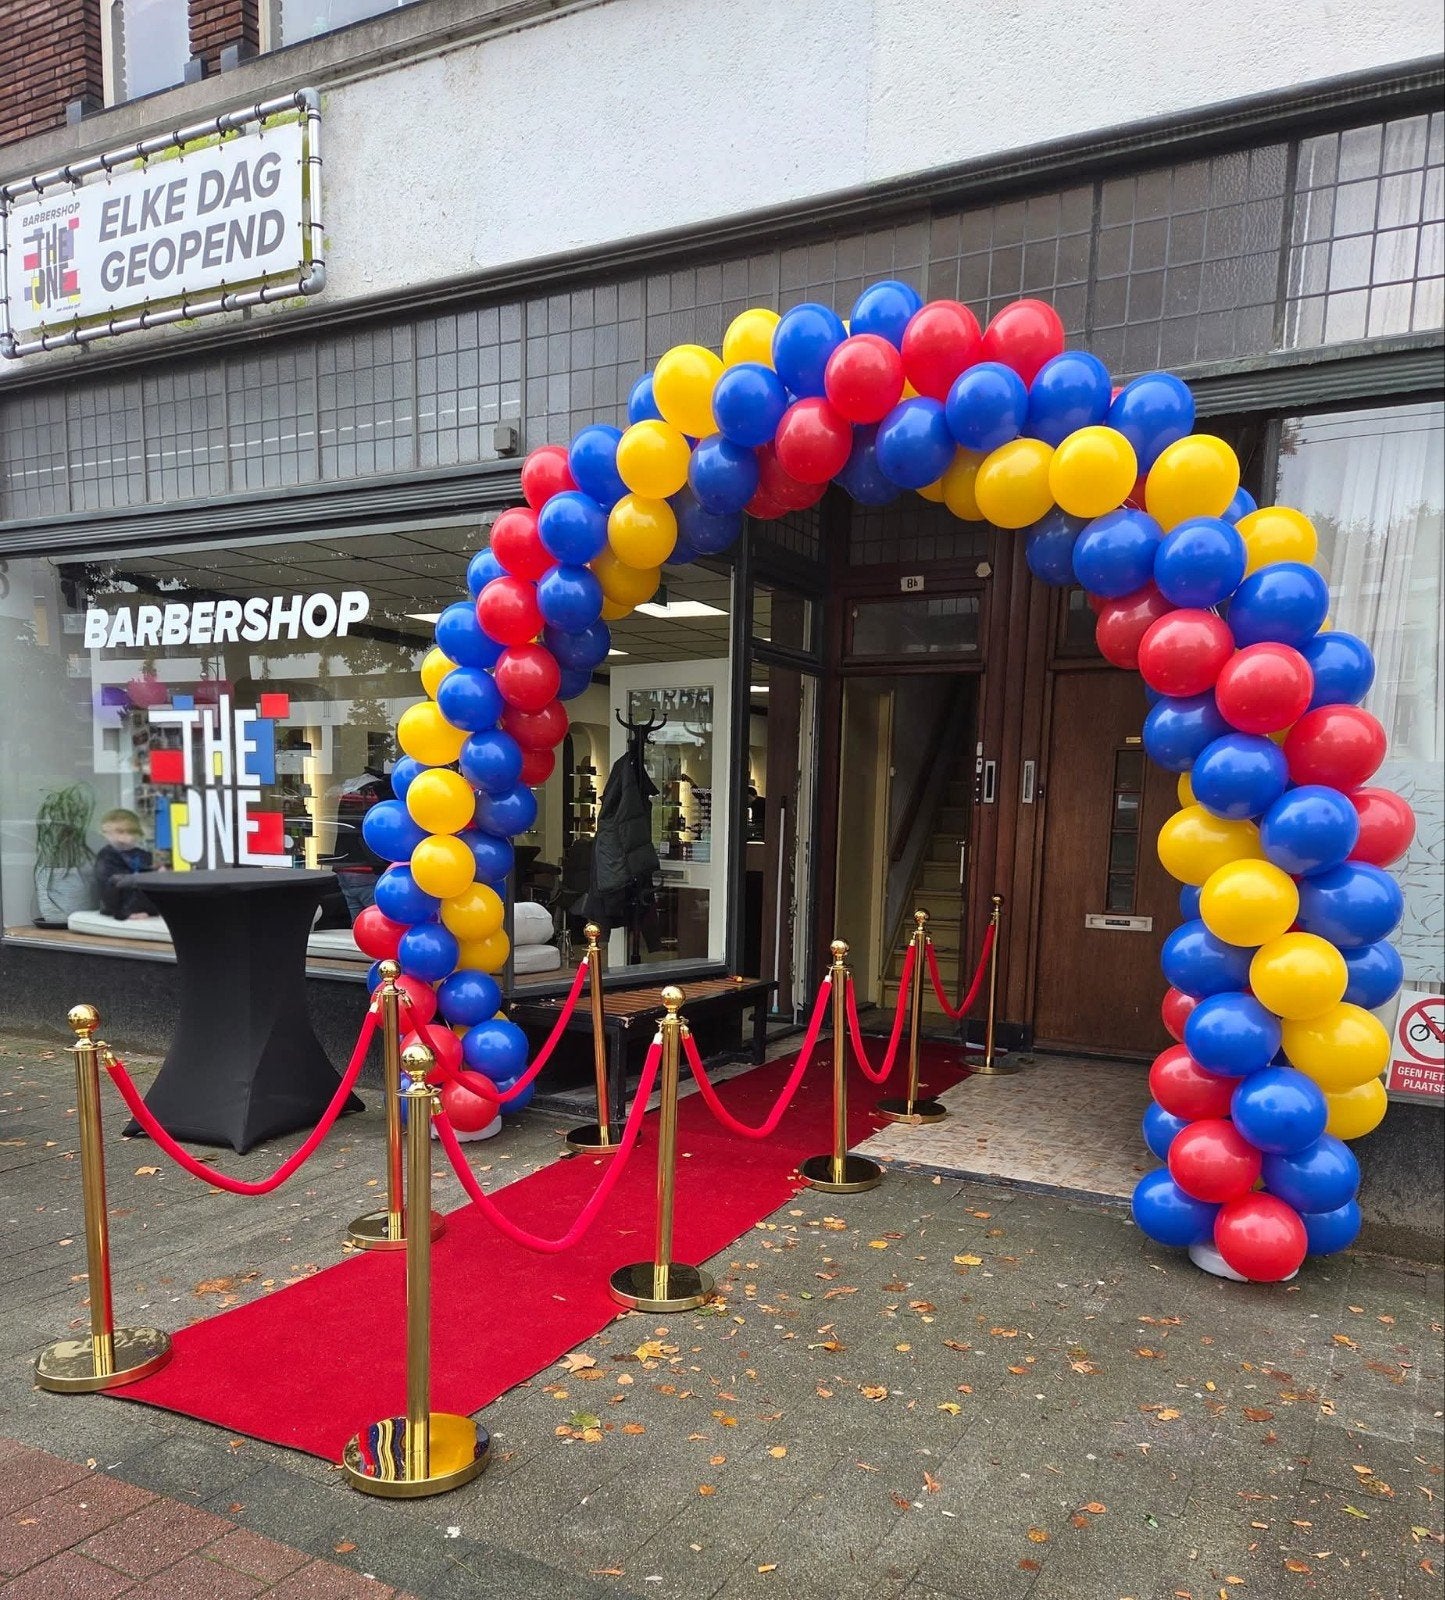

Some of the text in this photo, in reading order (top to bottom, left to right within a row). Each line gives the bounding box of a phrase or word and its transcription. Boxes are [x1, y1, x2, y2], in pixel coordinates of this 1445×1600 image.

[22, 202, 80, 227] BARBERSHOP
[99, 151, 282, 243] ELKE DAG
[23, 223, 70, 268] THE
[100, 209, 285, 293] GEOPEND
[84, 590, 370, 648] BARBERSHOP
[149, 694, 261, 786] THE
[1397, 1066, 1444, 1082] GEEN FIET
